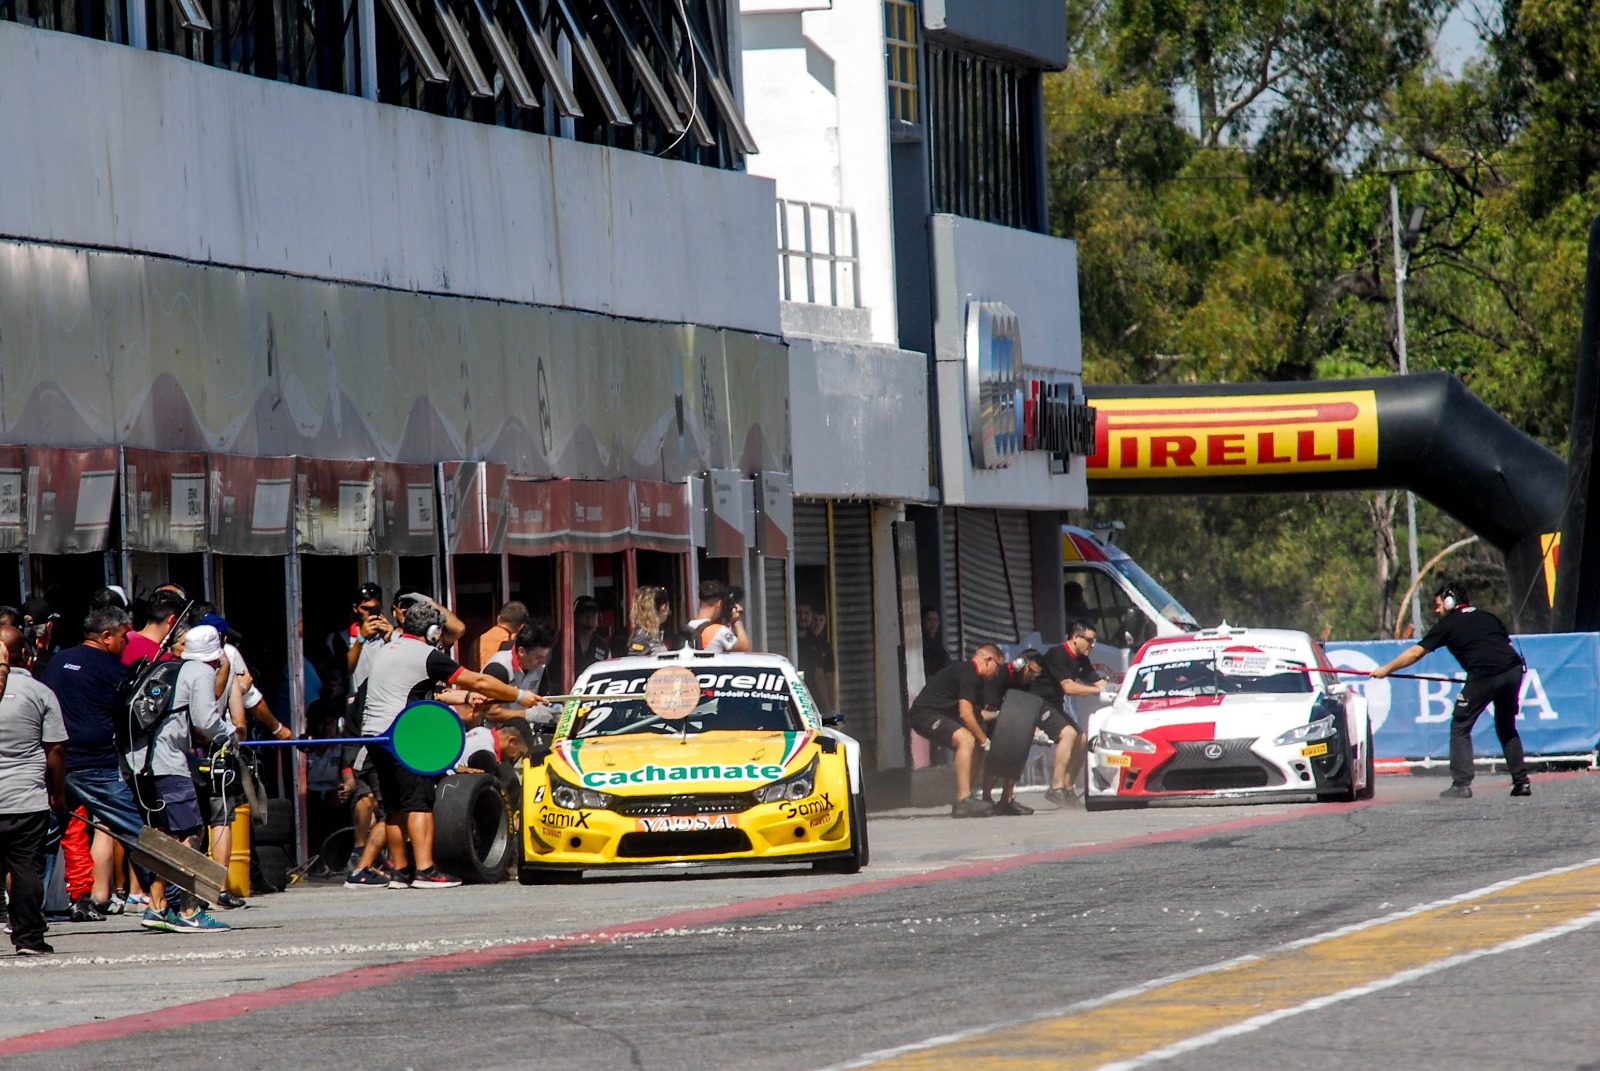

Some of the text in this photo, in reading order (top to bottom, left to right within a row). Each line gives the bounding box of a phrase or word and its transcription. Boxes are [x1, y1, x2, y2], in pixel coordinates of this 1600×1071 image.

[1087, 402, 1359, 469] PIRELLI
[586, 673, 785, 696] Tarorelli
[1142, 671, 1156, 692] 1
[751, 690, 790, 701] Cristales
[1415, 669, 1559, 724] BA
[575, 706, 613, 738] 2
[583, 764, 783, 787] Cachamate
